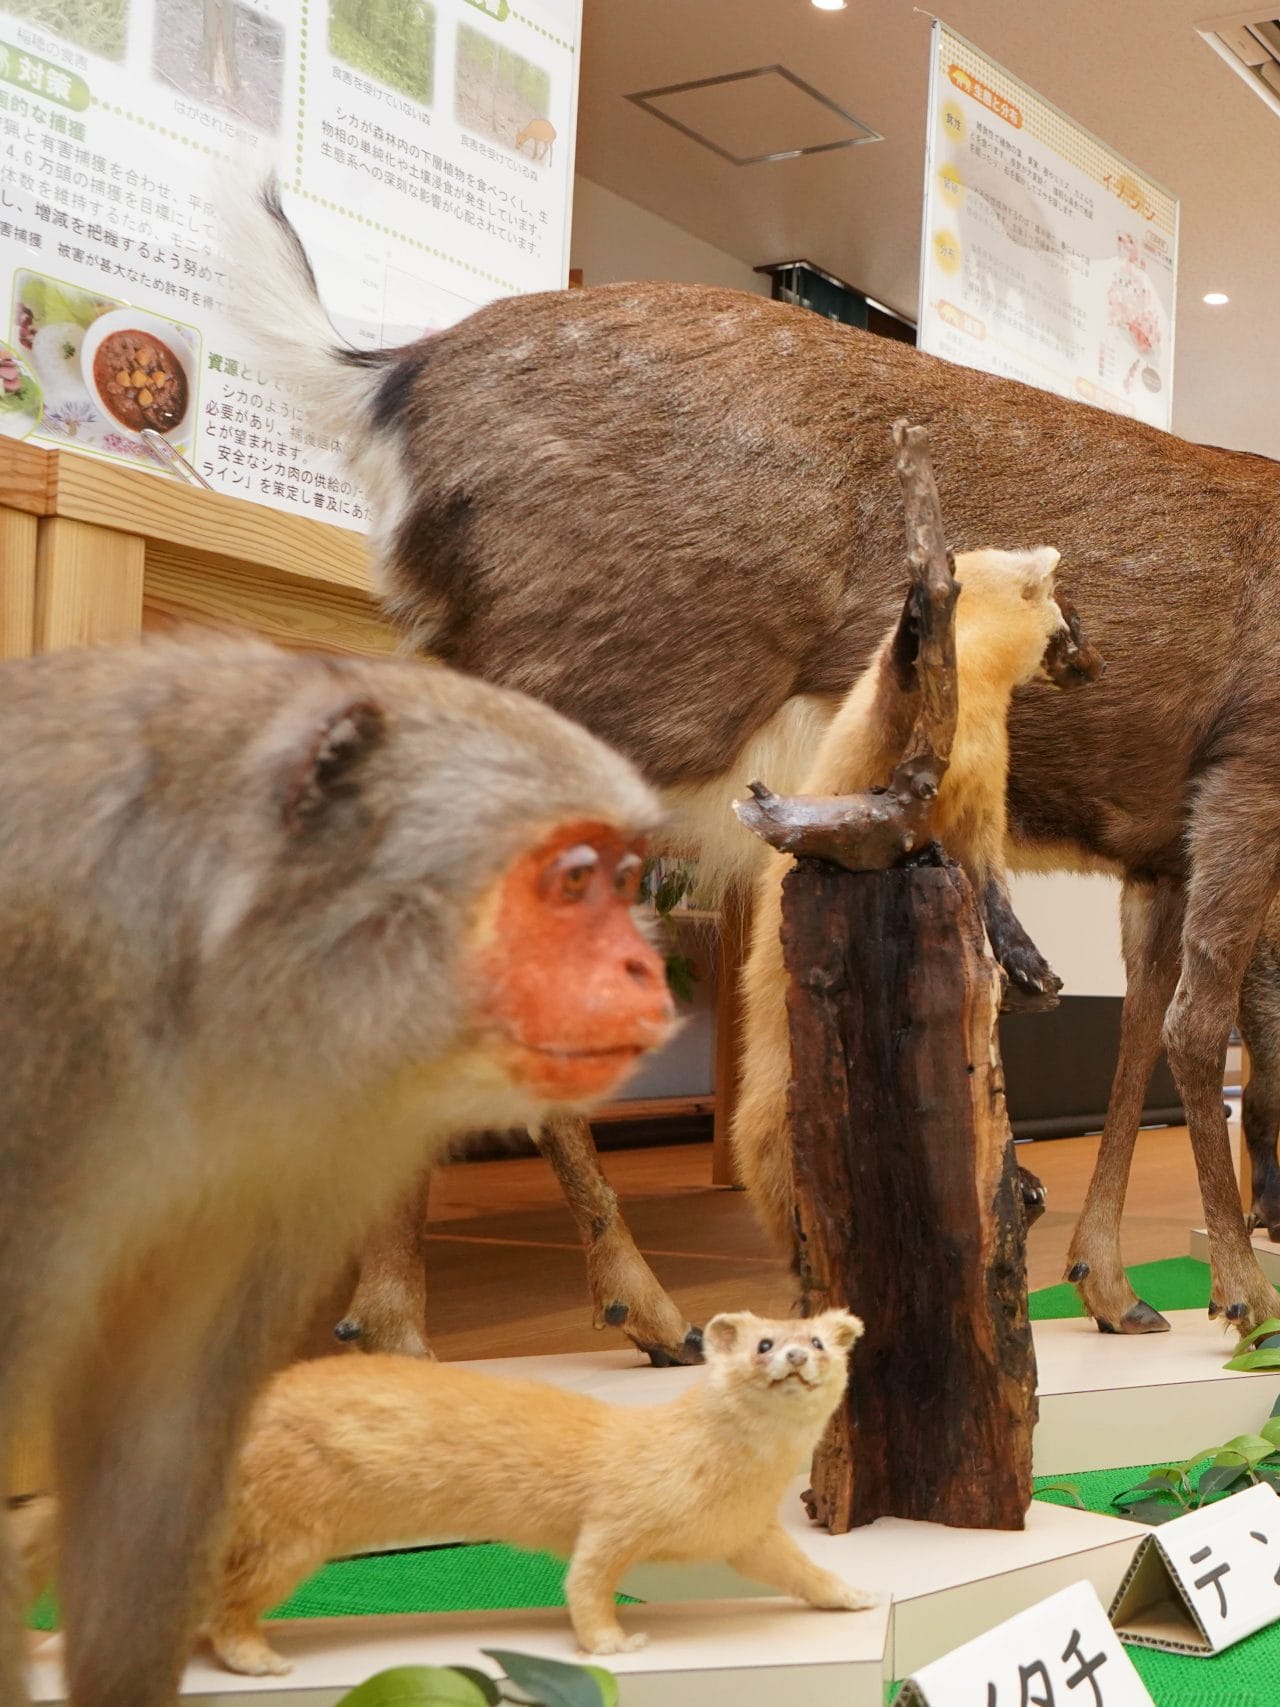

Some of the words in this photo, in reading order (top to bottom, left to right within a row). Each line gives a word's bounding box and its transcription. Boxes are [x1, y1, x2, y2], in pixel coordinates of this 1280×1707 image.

[18, 56, 73, 102] 対策
[331, 65, 431, 126] 食害を受けていない森
